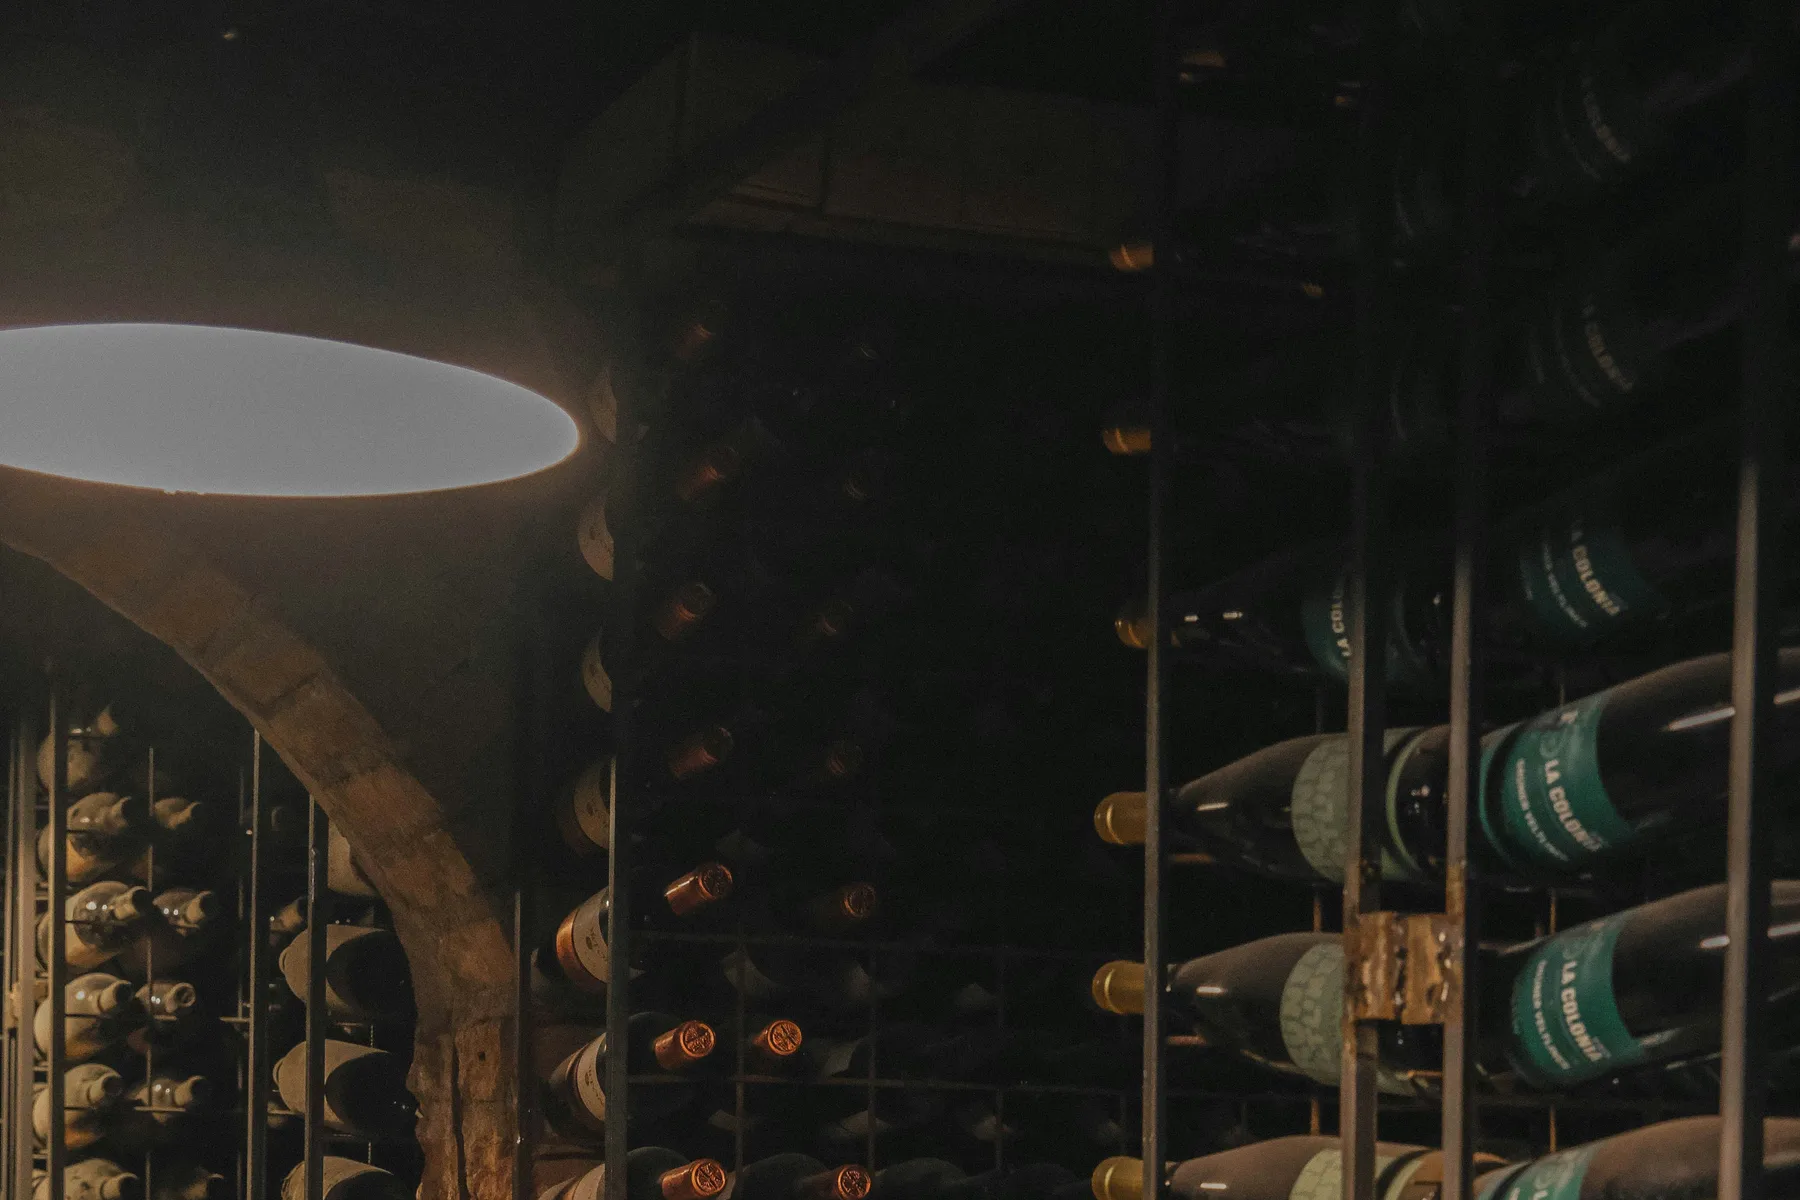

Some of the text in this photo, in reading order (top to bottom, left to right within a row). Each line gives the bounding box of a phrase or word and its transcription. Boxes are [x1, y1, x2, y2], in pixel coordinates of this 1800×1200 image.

[1336, 637, 1352, 657] LA
[1544, 759, 1603, 852] LA COLONIA
[1560, 960, 1604, 1062] LA COLONIA
